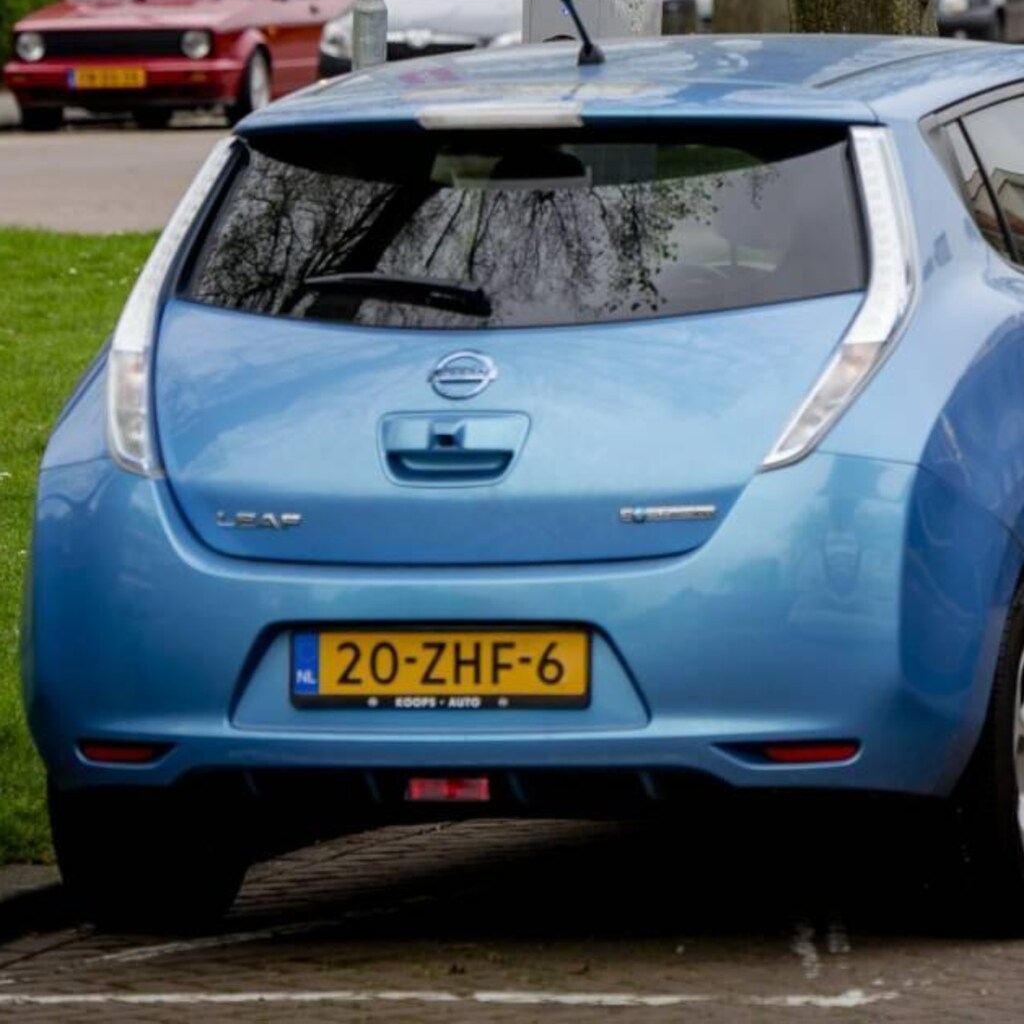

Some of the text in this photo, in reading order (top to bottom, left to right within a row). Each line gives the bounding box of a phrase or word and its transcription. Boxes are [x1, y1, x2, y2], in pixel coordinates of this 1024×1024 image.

[216, 511, 302, 528] LEAF
[296, 642, 565, 685] NL 20-ZHF-6
[395, 697, 482, 708] KOOPS AUTO
